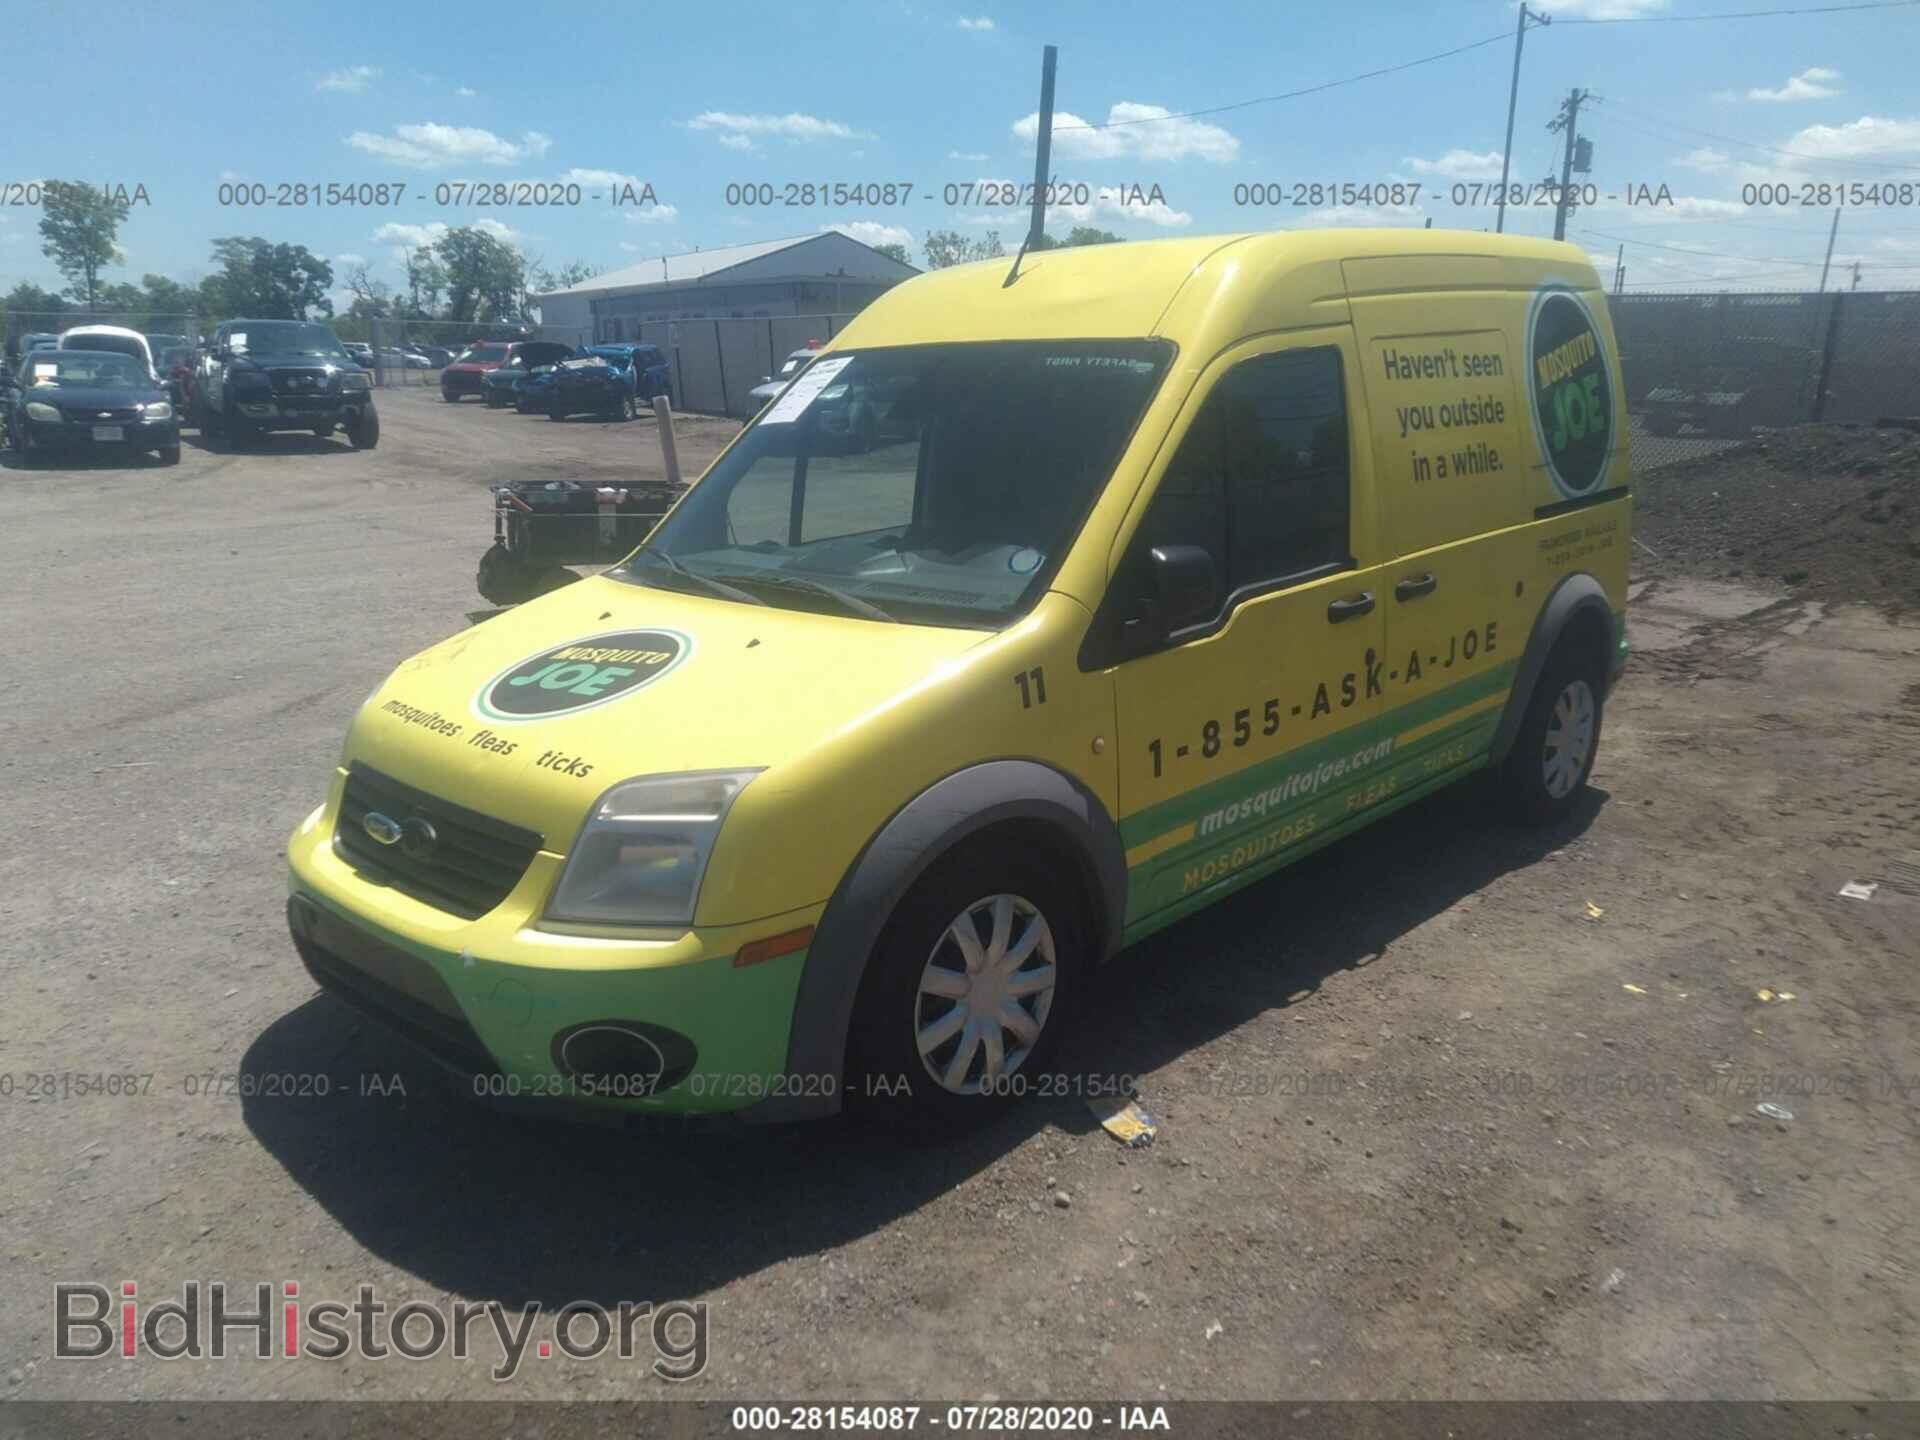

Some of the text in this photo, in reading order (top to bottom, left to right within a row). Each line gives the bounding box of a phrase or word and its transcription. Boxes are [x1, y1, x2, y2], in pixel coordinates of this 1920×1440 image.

[1383, 348, 1504, 380] Haven't seen
[1537, 331, 1596, 389] MOSQUITO
[1397, 394, 1505, 438] you outside
[1551, 373, 1604, 449] JOE
[1412, 441, 1504, 482] in a while.
[553, 647, 673, 665] MOSQUITO
[509, 662, 636, 696] JOE
[1014, 665, 1047, 709] 11
[381, 699, 595, 778] mosquitoes fleas ticks
[1200, 736, 1394, 836] mosquitojoe.com
[1183, 813, 1319, 893] MOSQUITOES
